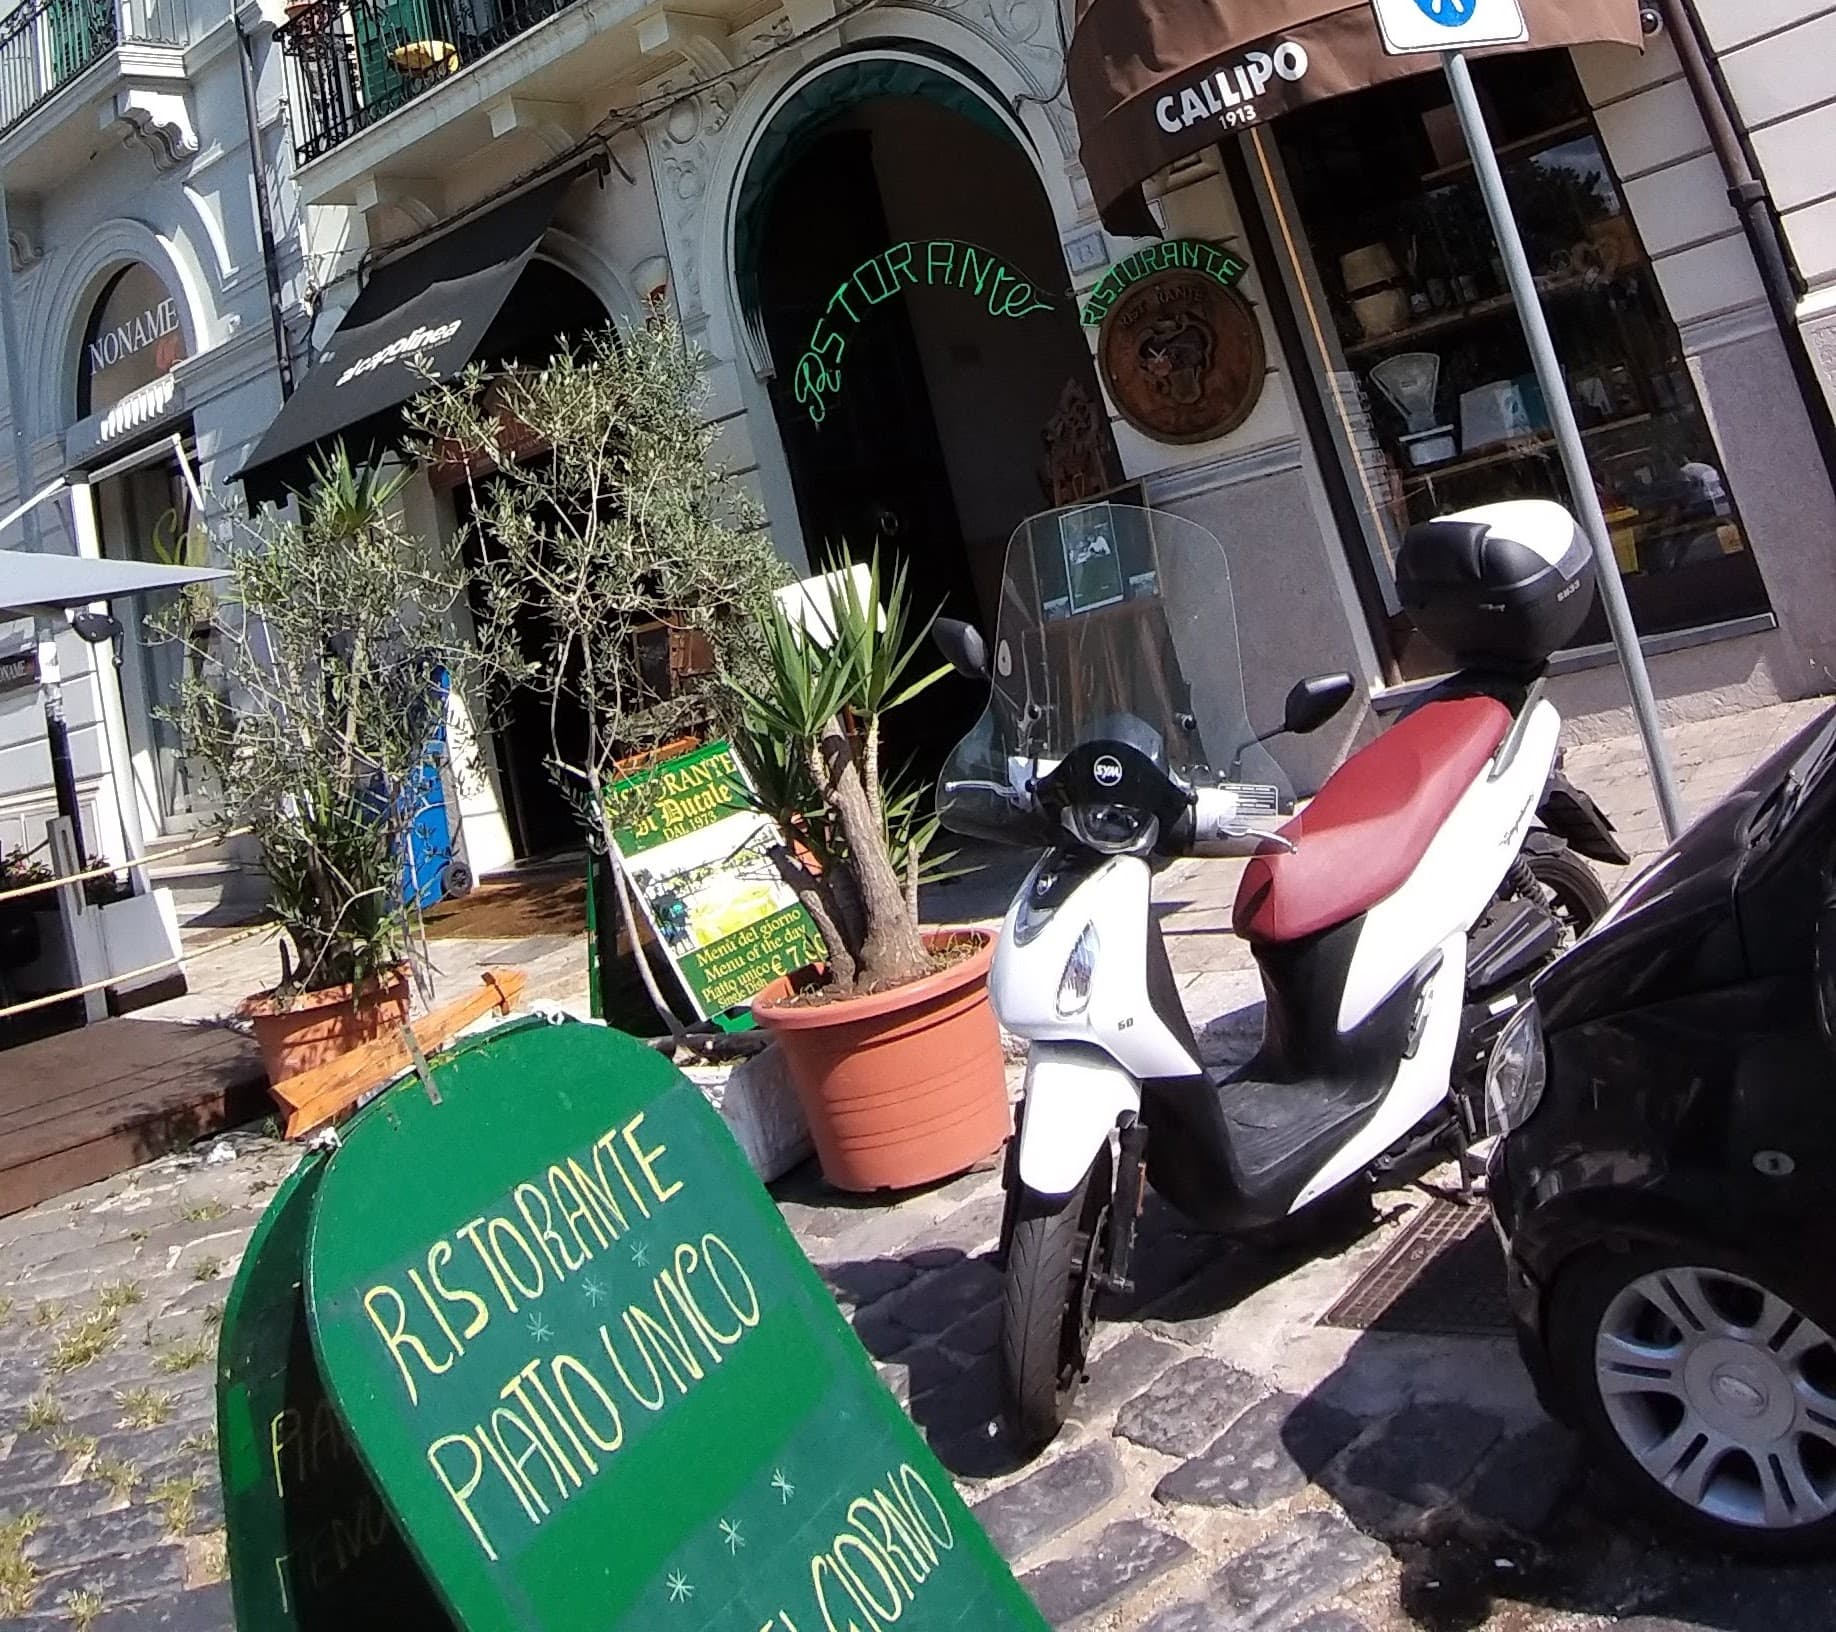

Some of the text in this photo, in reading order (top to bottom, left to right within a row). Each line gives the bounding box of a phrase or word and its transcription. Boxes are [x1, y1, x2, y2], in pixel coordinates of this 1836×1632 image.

[1155, 41, 1308, 134] CALLIPO
[1218, 104, 1257, 129] 1913
[1080, 241, 1243, 328] RISTORANTE
[88, 298, 179, 376] NONAME
[1097, 764, 1121, 779] SYM
[654, 781, 733, 827] Ducale
[663, 809, 719, 842] DAL 1973
[738, 928, 759, 948] del
[760, 909, 801, 941] giorno
[704, 924, 807, 983] Menu of the day
[771, 954, 788, 976] €
[702, 961, 771, 1005] Piatto unico
[718, 977, 768, 1010] Single Dish
[363, 1111, 684, 1408] RISTORANTE
[427, 1353, 624, 1561] PIATTO
[600, 1231, 762, 1412] UNICO
[811, 1462, 954, 1632] GIORNO
